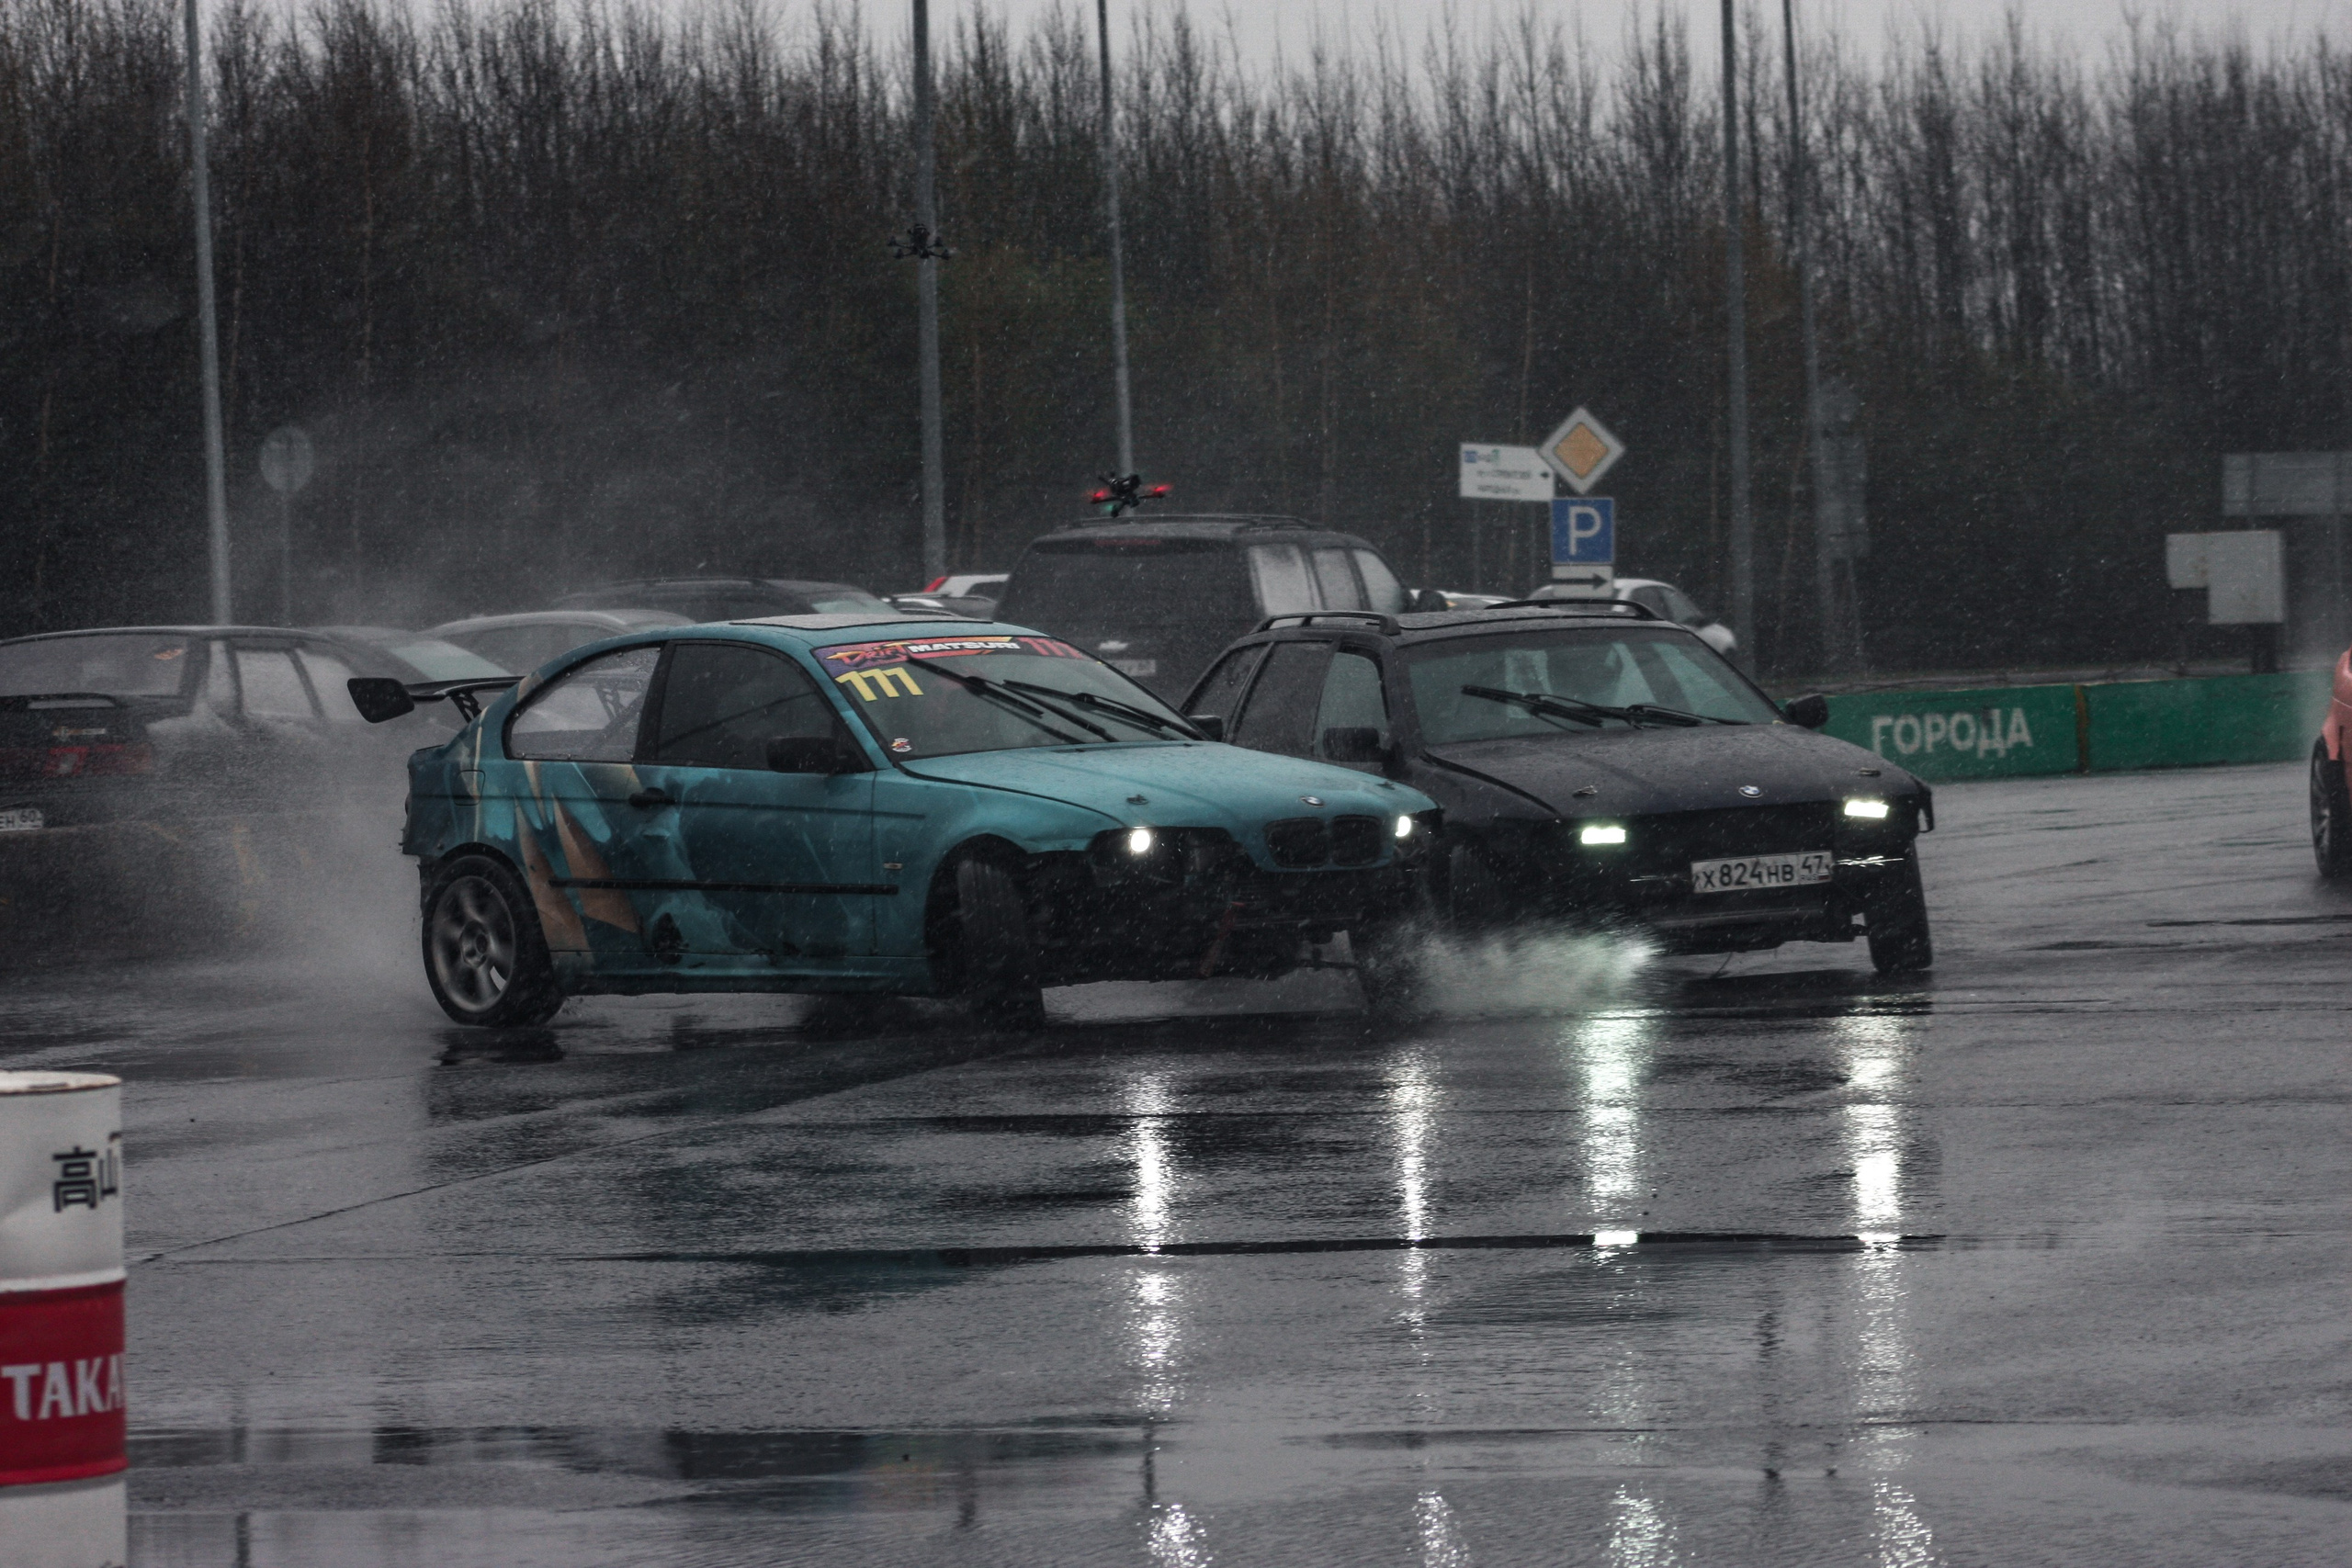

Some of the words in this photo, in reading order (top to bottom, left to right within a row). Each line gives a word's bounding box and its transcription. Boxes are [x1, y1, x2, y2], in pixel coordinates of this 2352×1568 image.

[1568, 505, 1602, 556] P
[908, 641, 1022, 653] MATSURI
[835, 667, 924, 702] 111
[1872, 708, 2034, 759] ГОРОДА
[1801, 855, 1824, 874] 47
